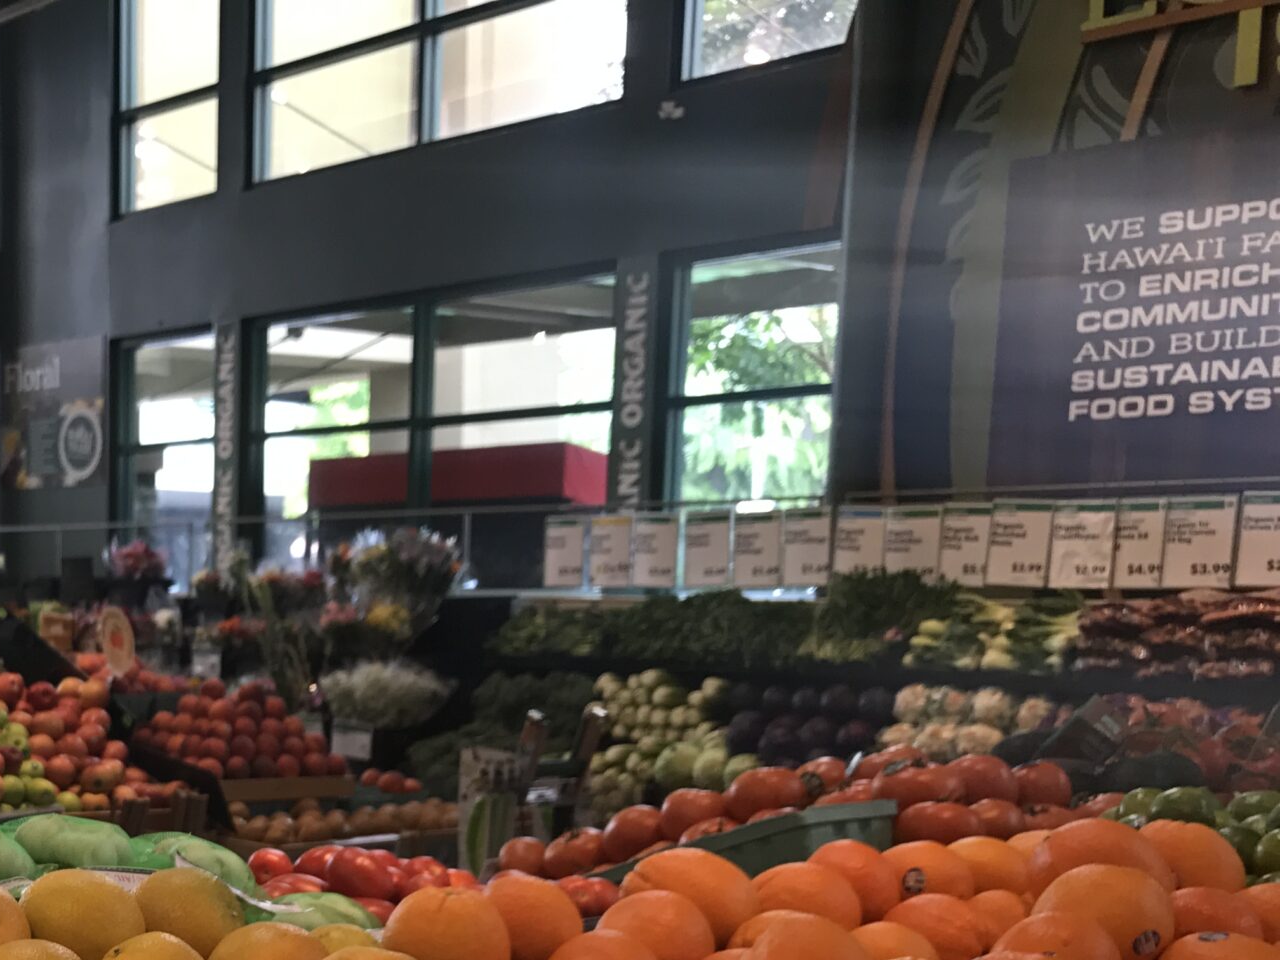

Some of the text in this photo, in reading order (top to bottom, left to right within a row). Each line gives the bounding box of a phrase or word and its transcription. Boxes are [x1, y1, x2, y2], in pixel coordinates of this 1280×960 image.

[1085, 217, 1145, 244] WE
[1079, 280, 1126, 304] TO
[621, 271, 649, 429] ORGANIC
[1072, 325, 1280, 364] AND BUILD
[4, 356, 61, 393] Floral
[216, 335, 236, 460] ORGANIC
[1068, 386, 1280, 422] FOOD SYS
